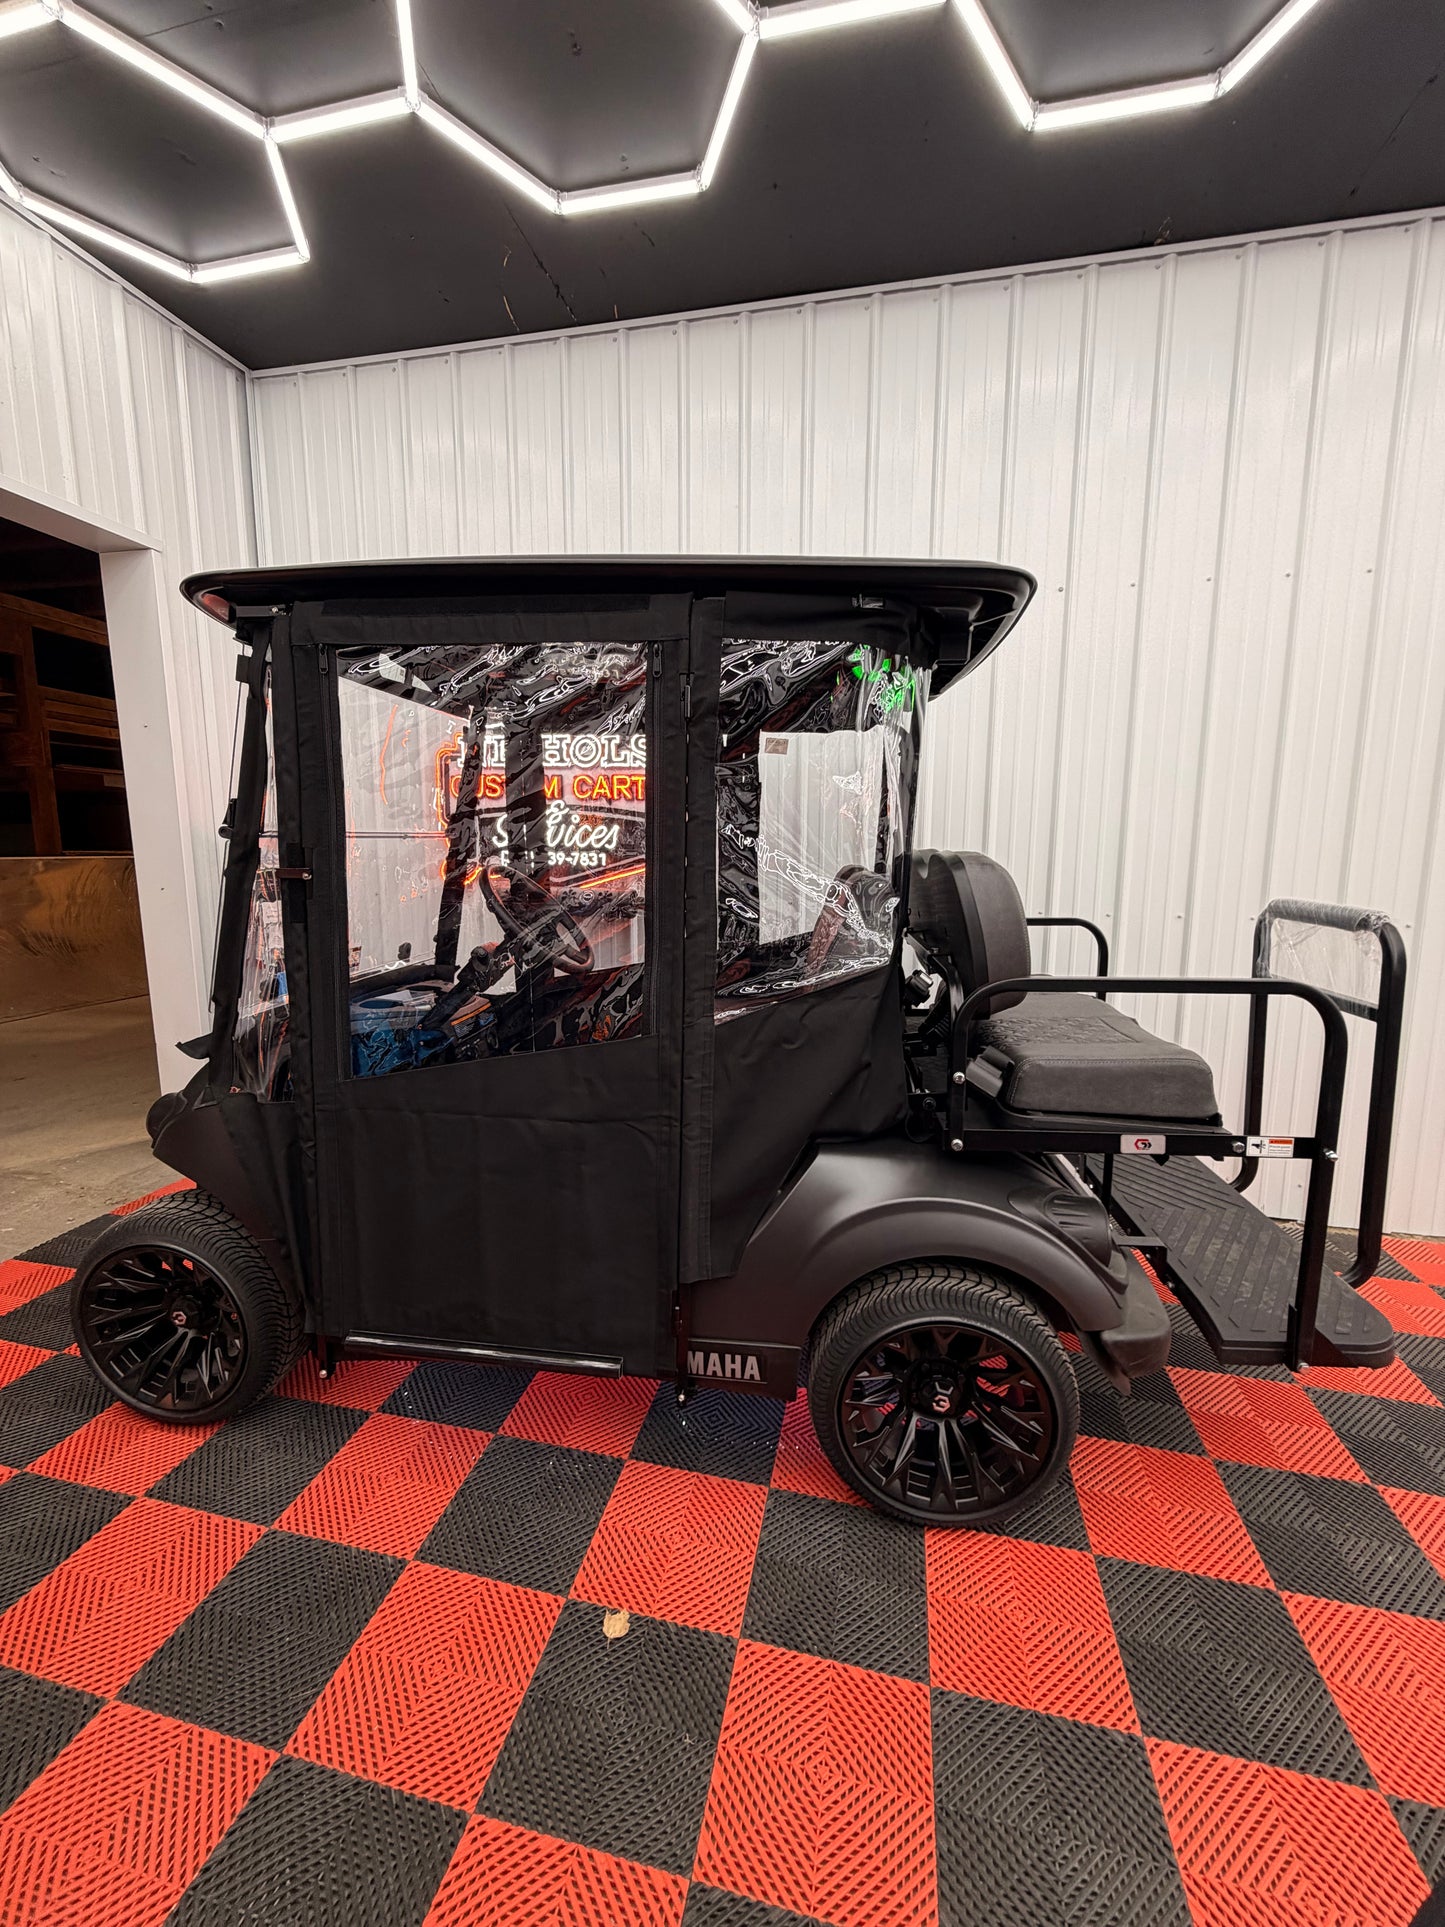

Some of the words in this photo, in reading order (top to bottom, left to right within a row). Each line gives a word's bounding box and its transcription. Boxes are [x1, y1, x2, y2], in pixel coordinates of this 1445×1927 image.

[456, 734, 646, 768] IHOLS
[449, 774, 563, 799] CSM
[492, 813, 620, 849] Svices
